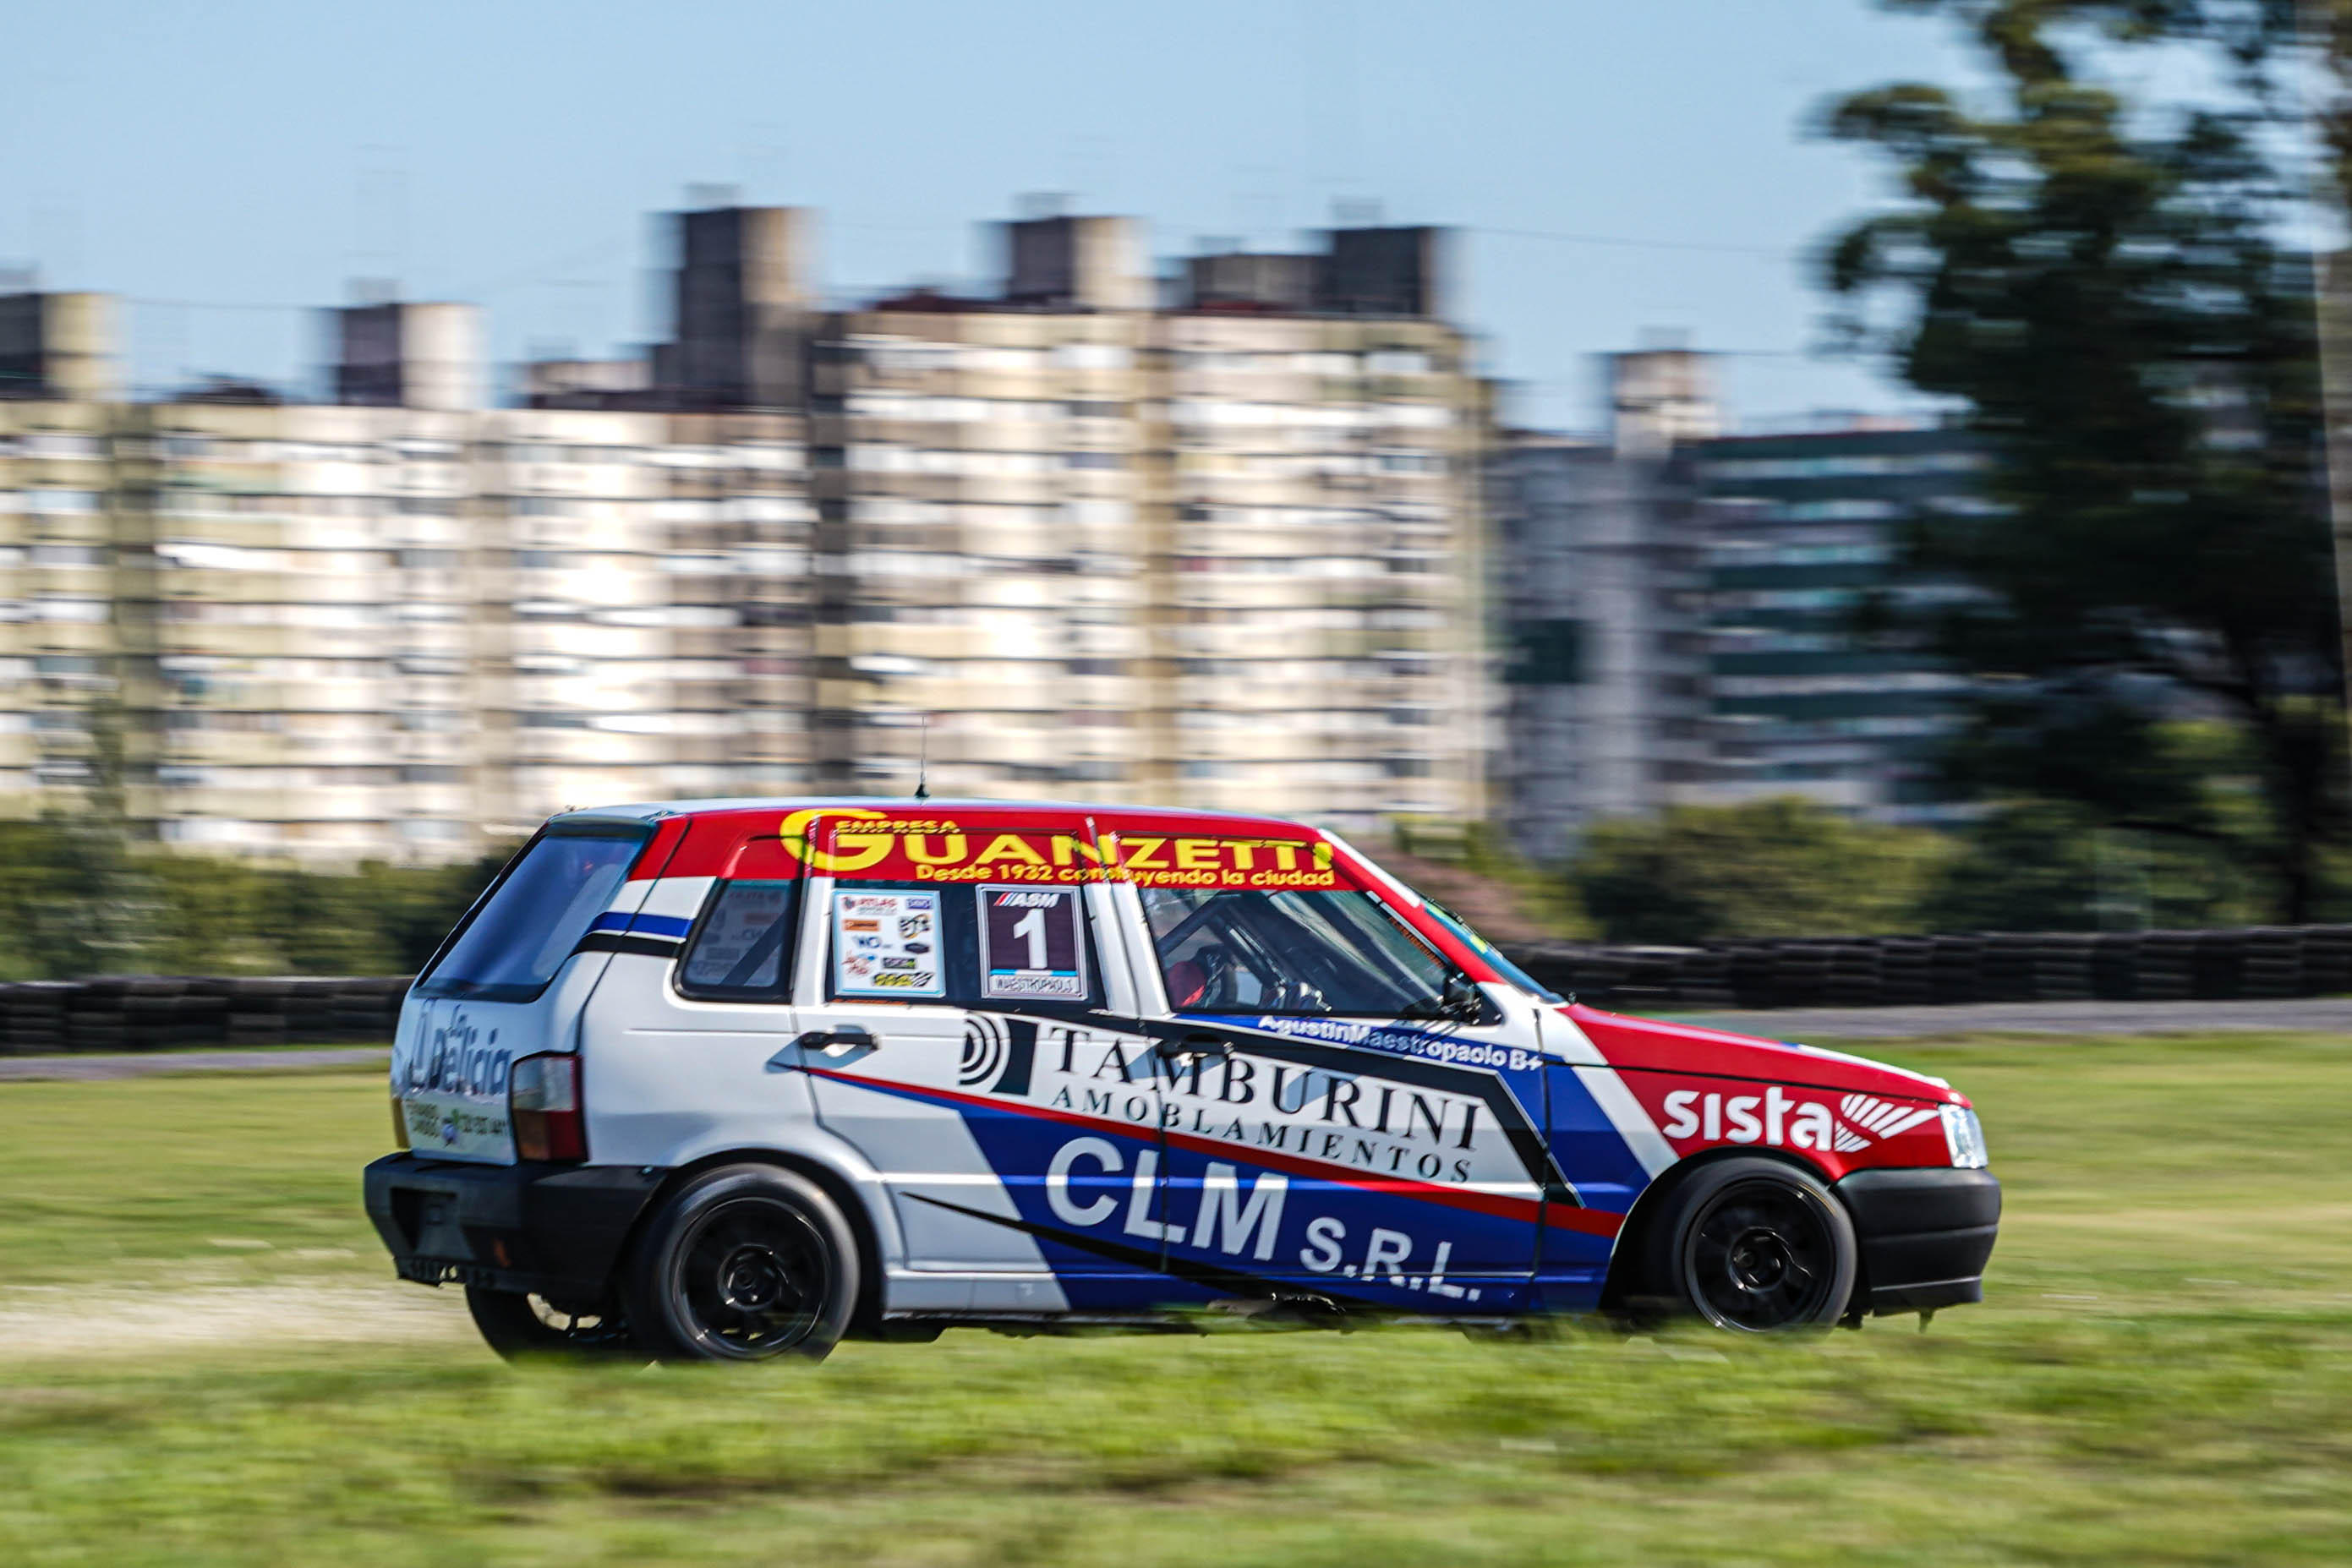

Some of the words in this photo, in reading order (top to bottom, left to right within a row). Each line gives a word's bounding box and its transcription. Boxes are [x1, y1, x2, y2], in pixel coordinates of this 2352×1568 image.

[779, 808, 1334, 871] GUANZETTI
[834, 820, 961, 833] EMPRESA
[916, 863, 993, 881] Desde
[998, 864, 1054, 881] 1932
[1222, 869, 1246, 885] la
[1250, 869, 1335, 886] ciudad
[1013, 908, 1048, 970] 1
[1050, 1026, 1480, 1152] TAMBURINI
[1663, 1086, 1833, 1151] sista
[1051, 1084, 1472, 1183] AMOBLAMIENTOS
[1046, 1137, 1289, 1261] CLM
[1299, 1216, 1481, 1302] S.R.L.
